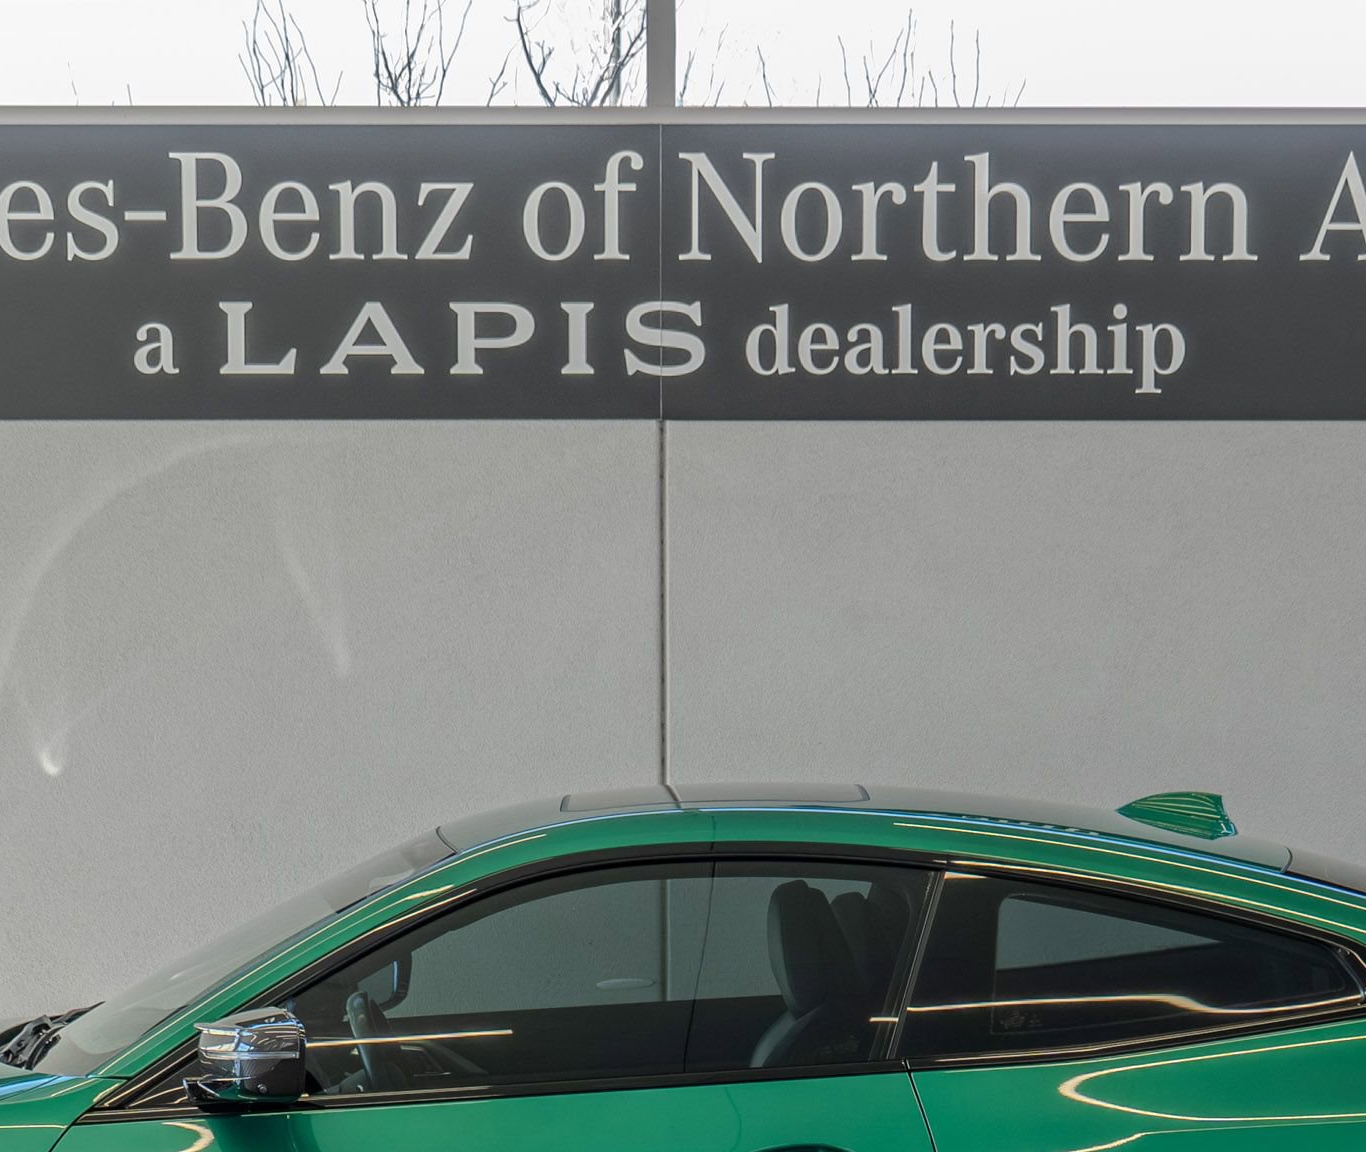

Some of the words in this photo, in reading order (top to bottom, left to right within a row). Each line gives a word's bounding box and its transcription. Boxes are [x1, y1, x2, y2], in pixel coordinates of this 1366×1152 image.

[522, 149, 645, 262] of
[678, 150, 1258, 264] Northern
[133, 322, 180, 375] a
[218, 300, 706, 376] LAPIS
[745, 303, 1186, 394] dealership
